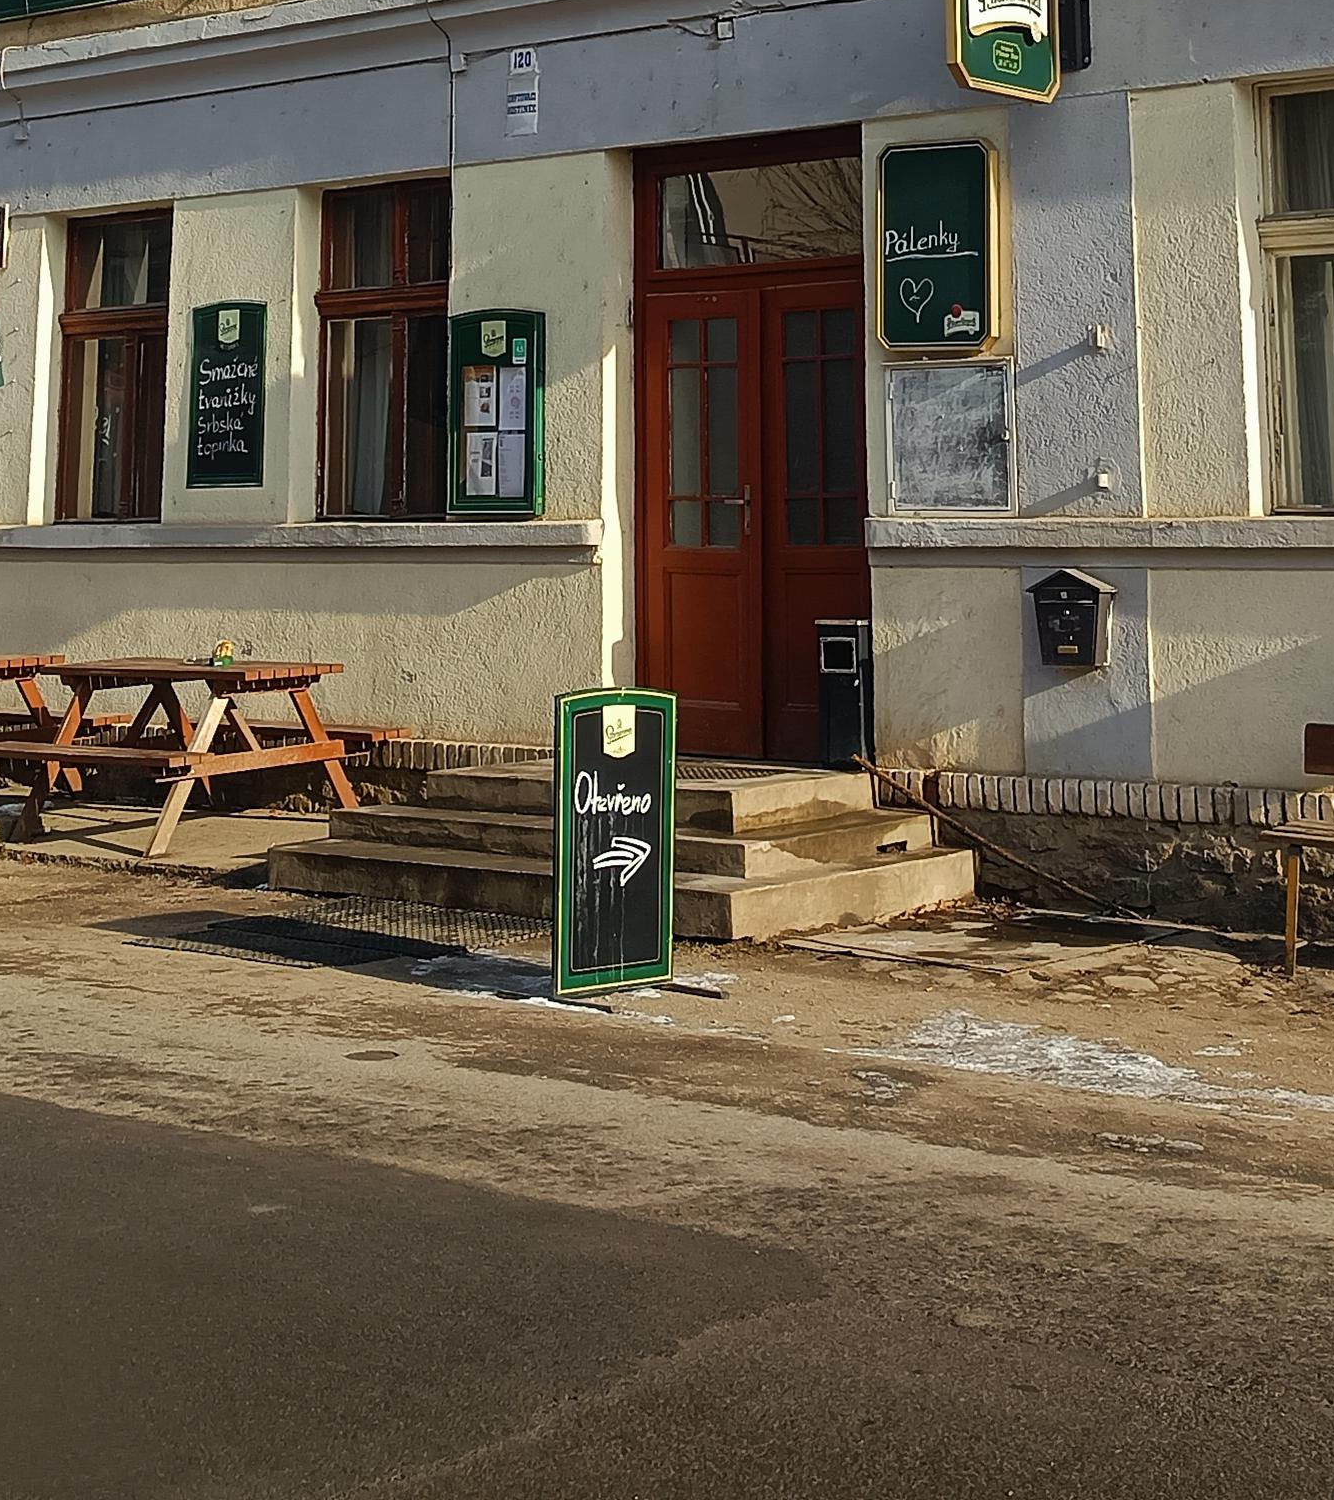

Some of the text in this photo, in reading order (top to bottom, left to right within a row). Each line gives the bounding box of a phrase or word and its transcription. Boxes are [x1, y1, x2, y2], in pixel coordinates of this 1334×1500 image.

[514, 51, 531, 69] 120
[885, 220, 960, 255] Pálenky
[197, 411, 244, 435] Srbská
[197, 431, 249, 460] topinka
[574, 770, 652, 816] Otevřeno
